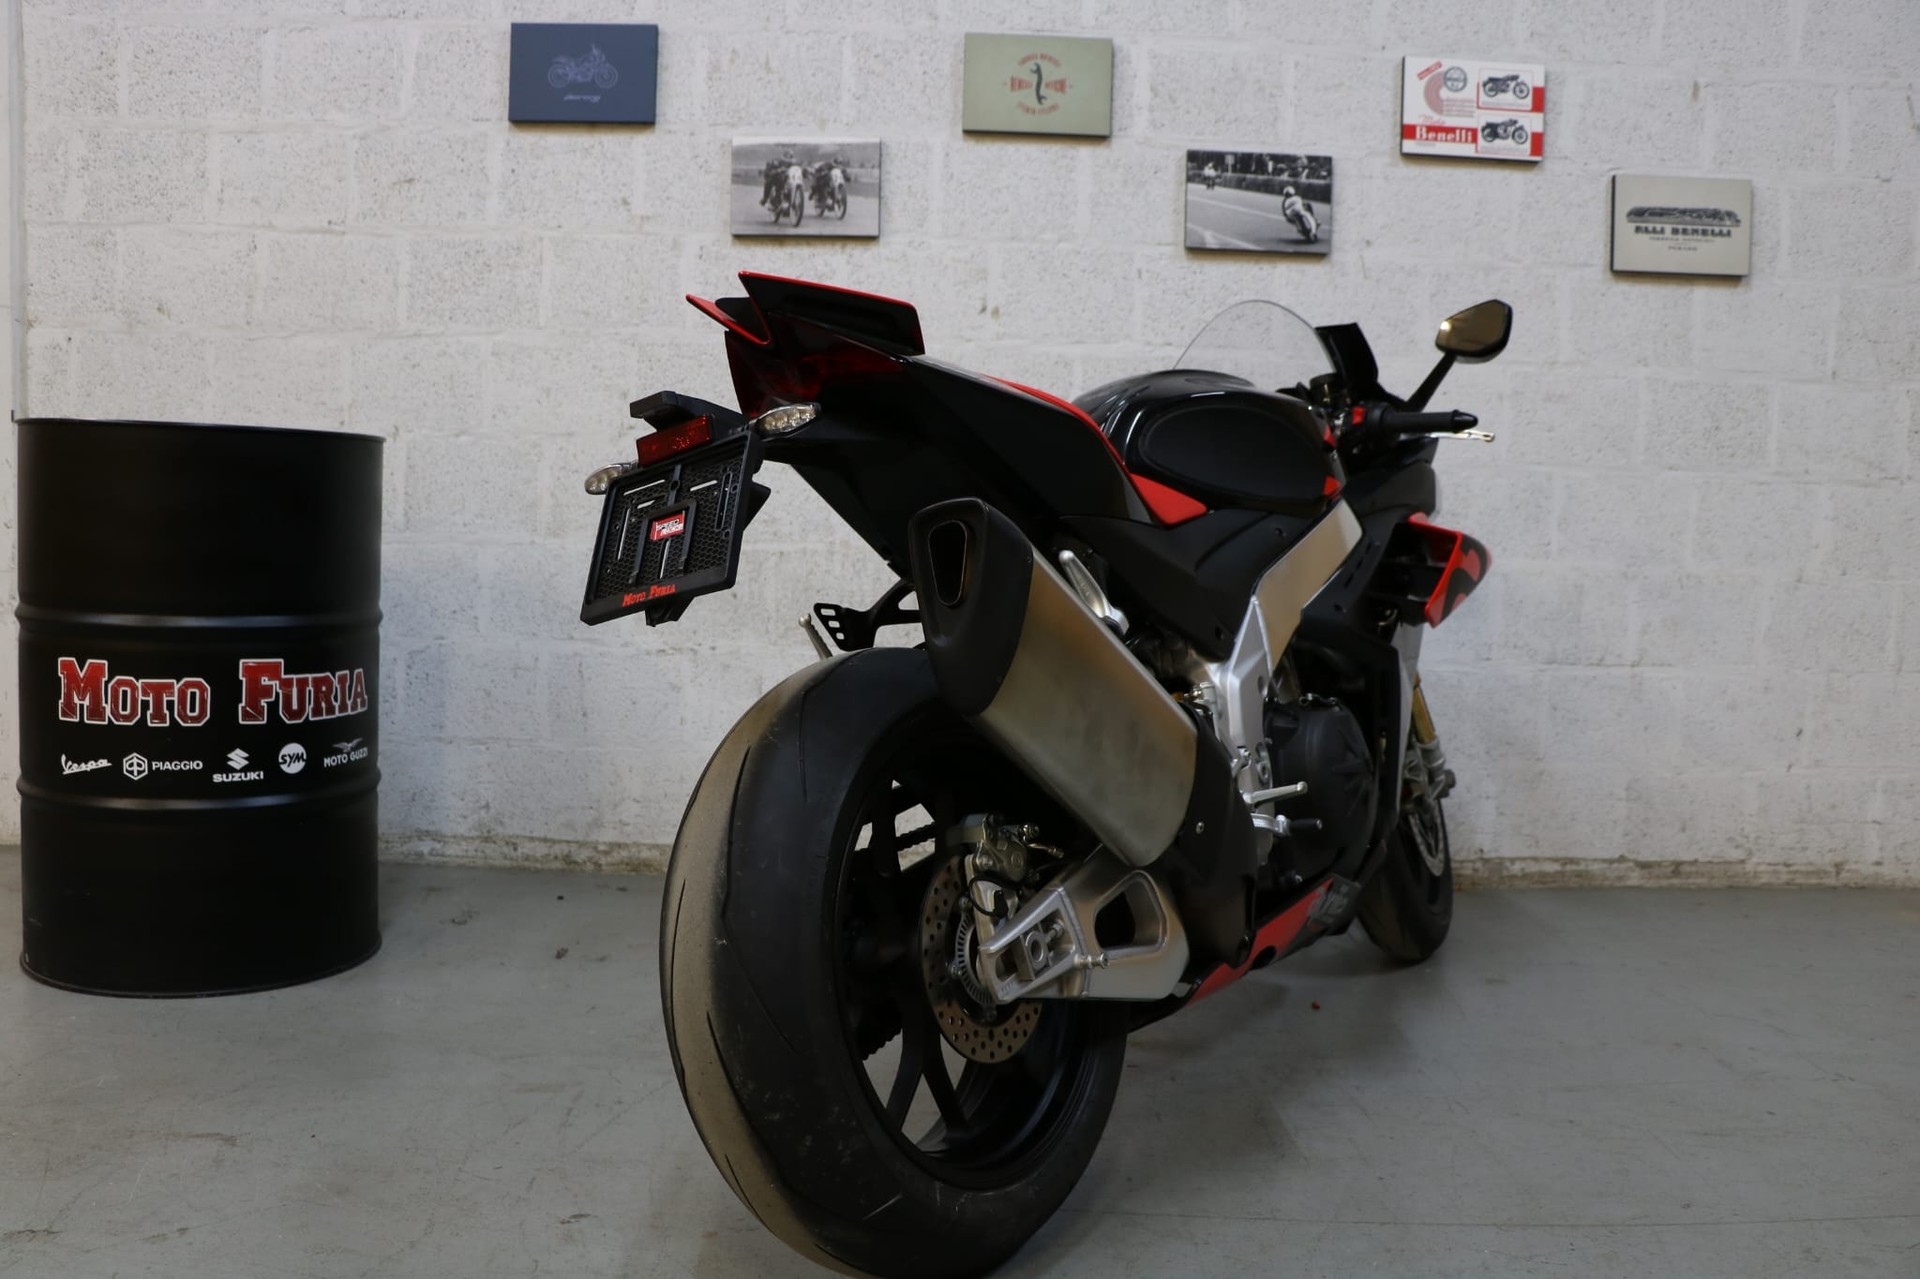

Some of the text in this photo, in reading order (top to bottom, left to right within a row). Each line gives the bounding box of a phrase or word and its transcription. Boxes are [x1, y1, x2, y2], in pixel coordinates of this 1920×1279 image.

[1415, 125, 1473, 144] Benelli
[58, 657, 368, 726] MOTO FURIA
[61, 753, 112, 775] Vespa
[152, 760, 203, 771] PIAGGIO
[279, 752, 306, 767] SYM
[323, 754, 349, 768] MOTO
[212, 771, 264, 783] SUZUKI
